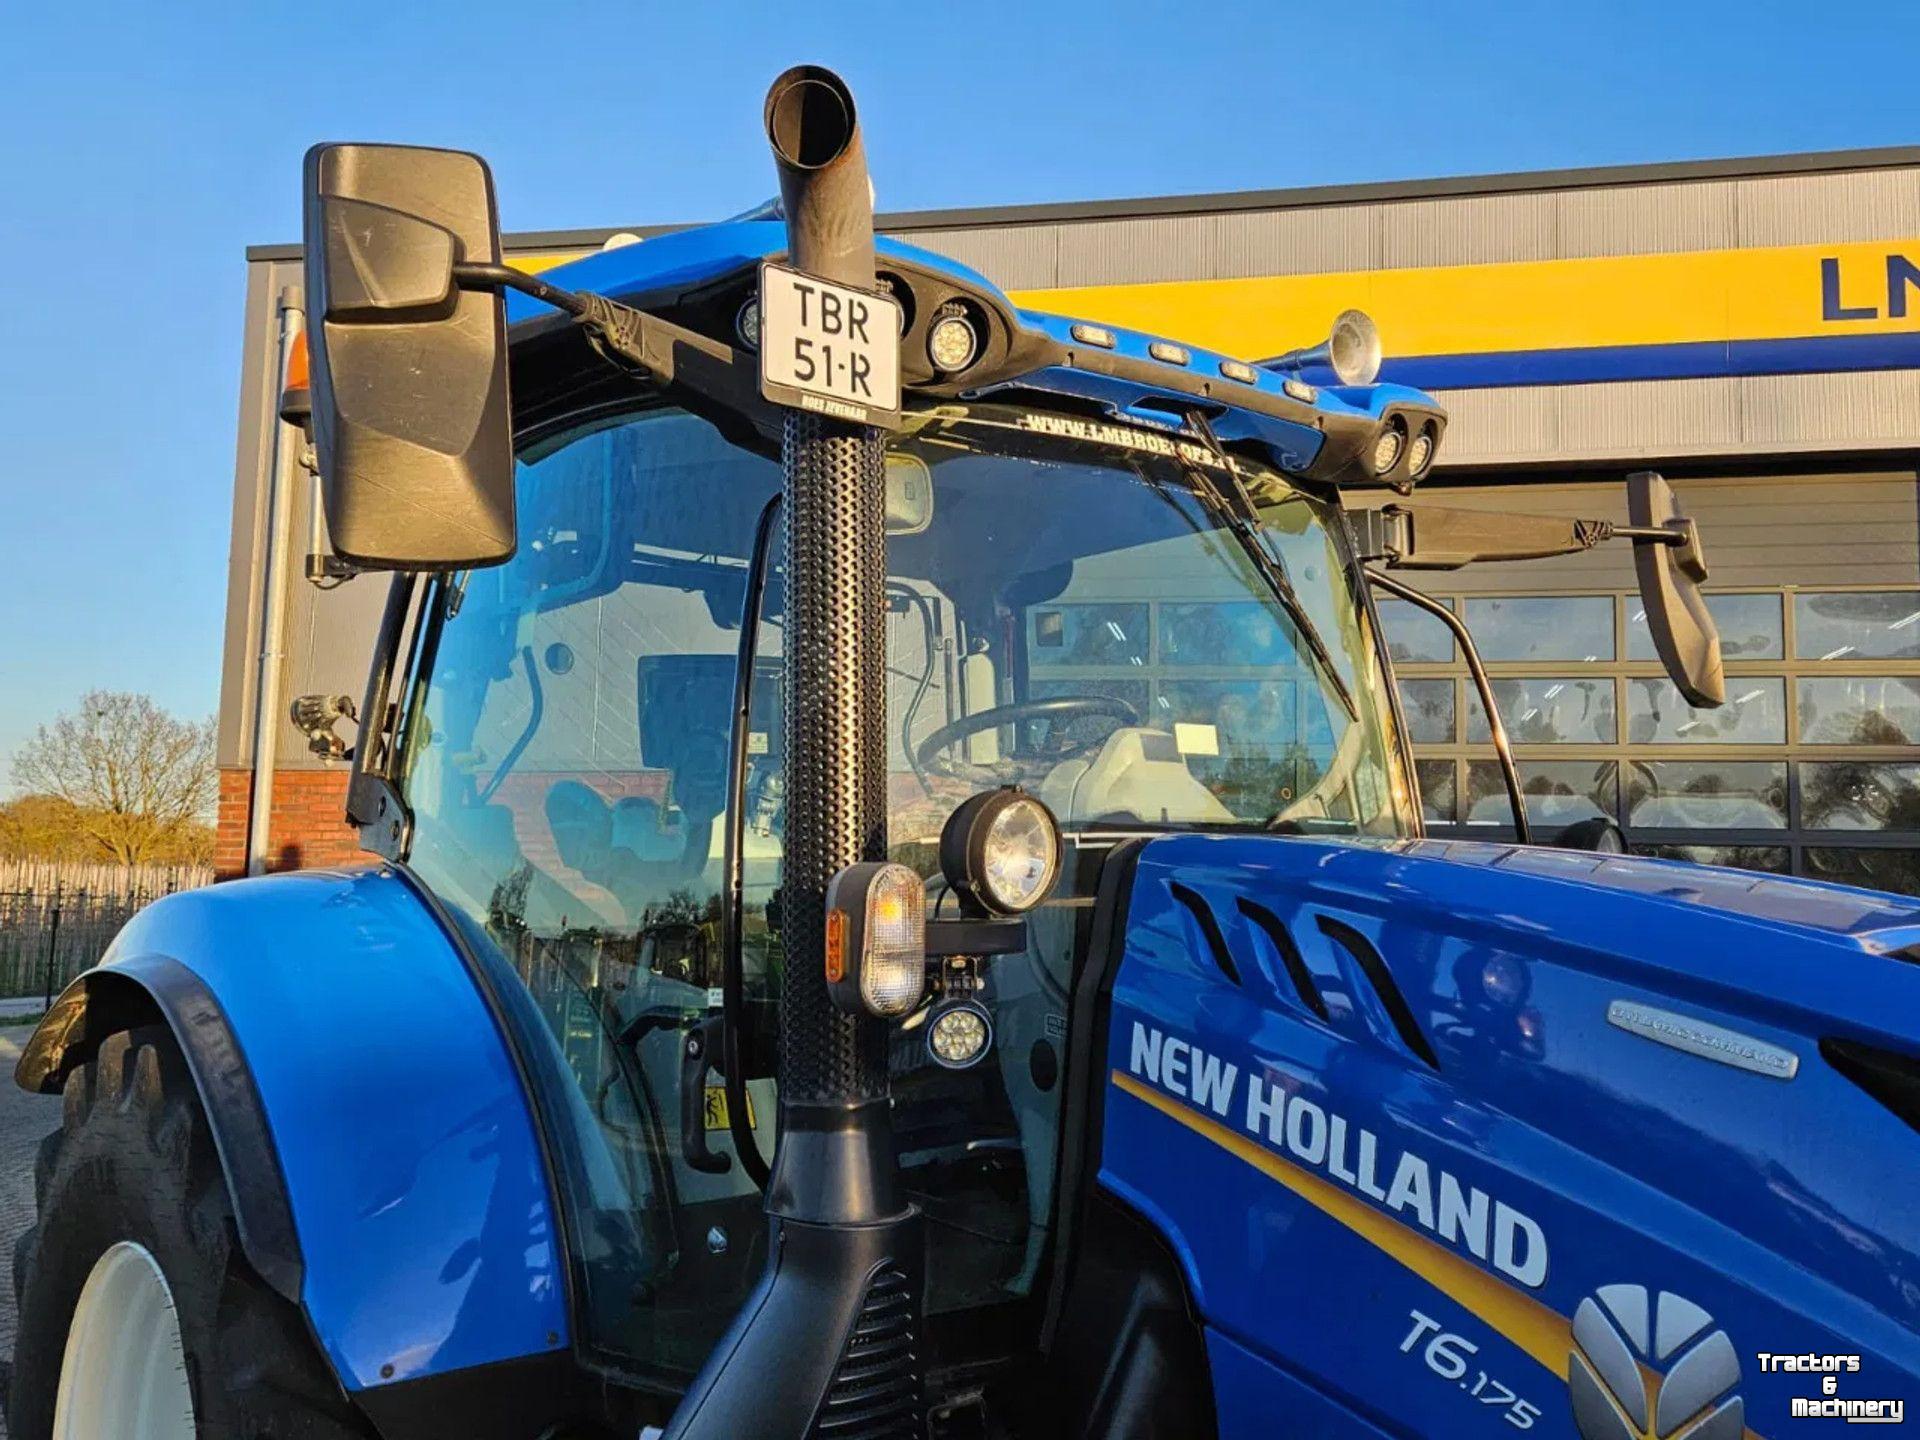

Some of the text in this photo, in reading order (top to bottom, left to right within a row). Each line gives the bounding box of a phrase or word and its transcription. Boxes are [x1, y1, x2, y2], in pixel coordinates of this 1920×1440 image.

[793, 282, 869, 344] TBR
[1026, 414, 1242, 474] WWW.LMBROEOFS.L
[1130, 1021, 1548, 1288] NEW HOLLAND
[1400, 1309, 1542, 1429] T6.175
